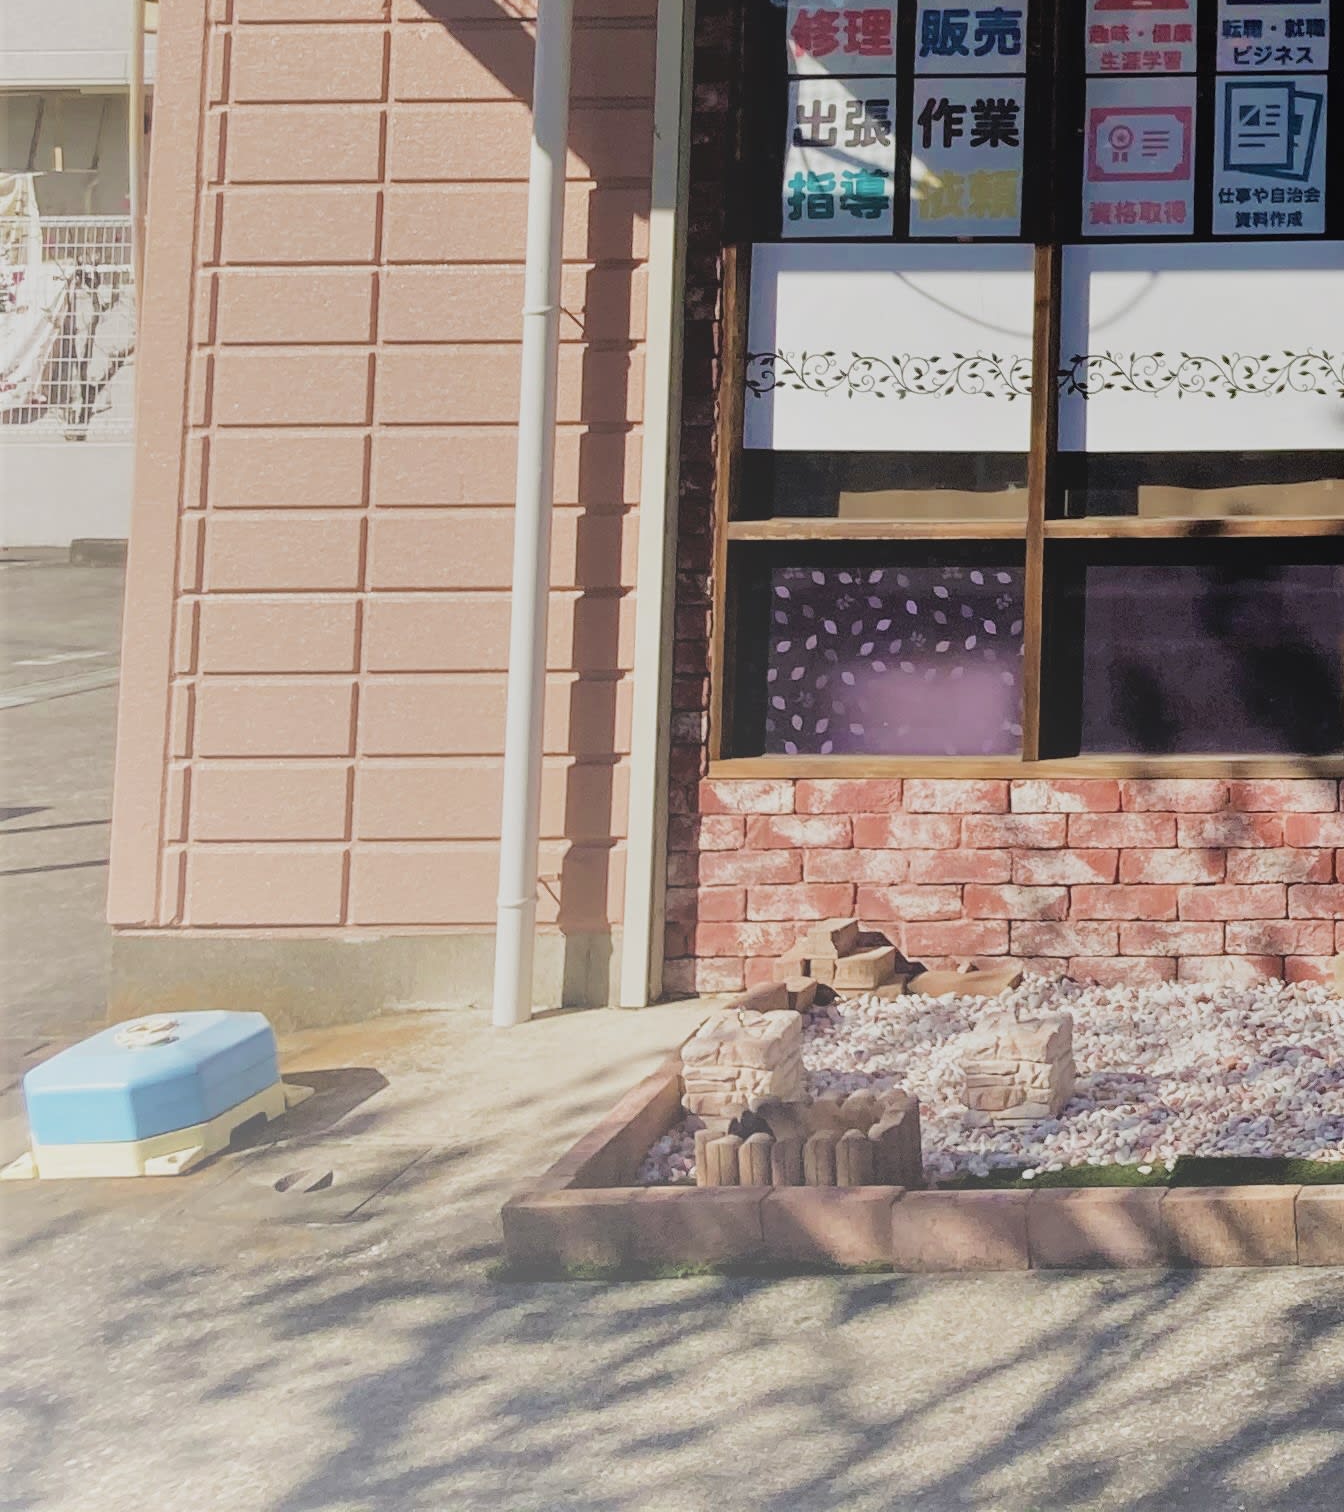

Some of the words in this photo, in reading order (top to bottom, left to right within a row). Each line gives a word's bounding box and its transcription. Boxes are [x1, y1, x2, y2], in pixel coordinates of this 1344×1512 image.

[791, 8, 893, 58] 修理
[919, 7, 1022, 58] 販売
[1233, 46, 1314, 66] ビジネス
[793, 99, 892, 148] 出張
[918, 98, 1021, 149] 作業
[788, 168, 891, 221] 指導
[1218, 187, 1321, 205] 仕事や自治会
[1235, 211, 1304, 229] 資料作成
